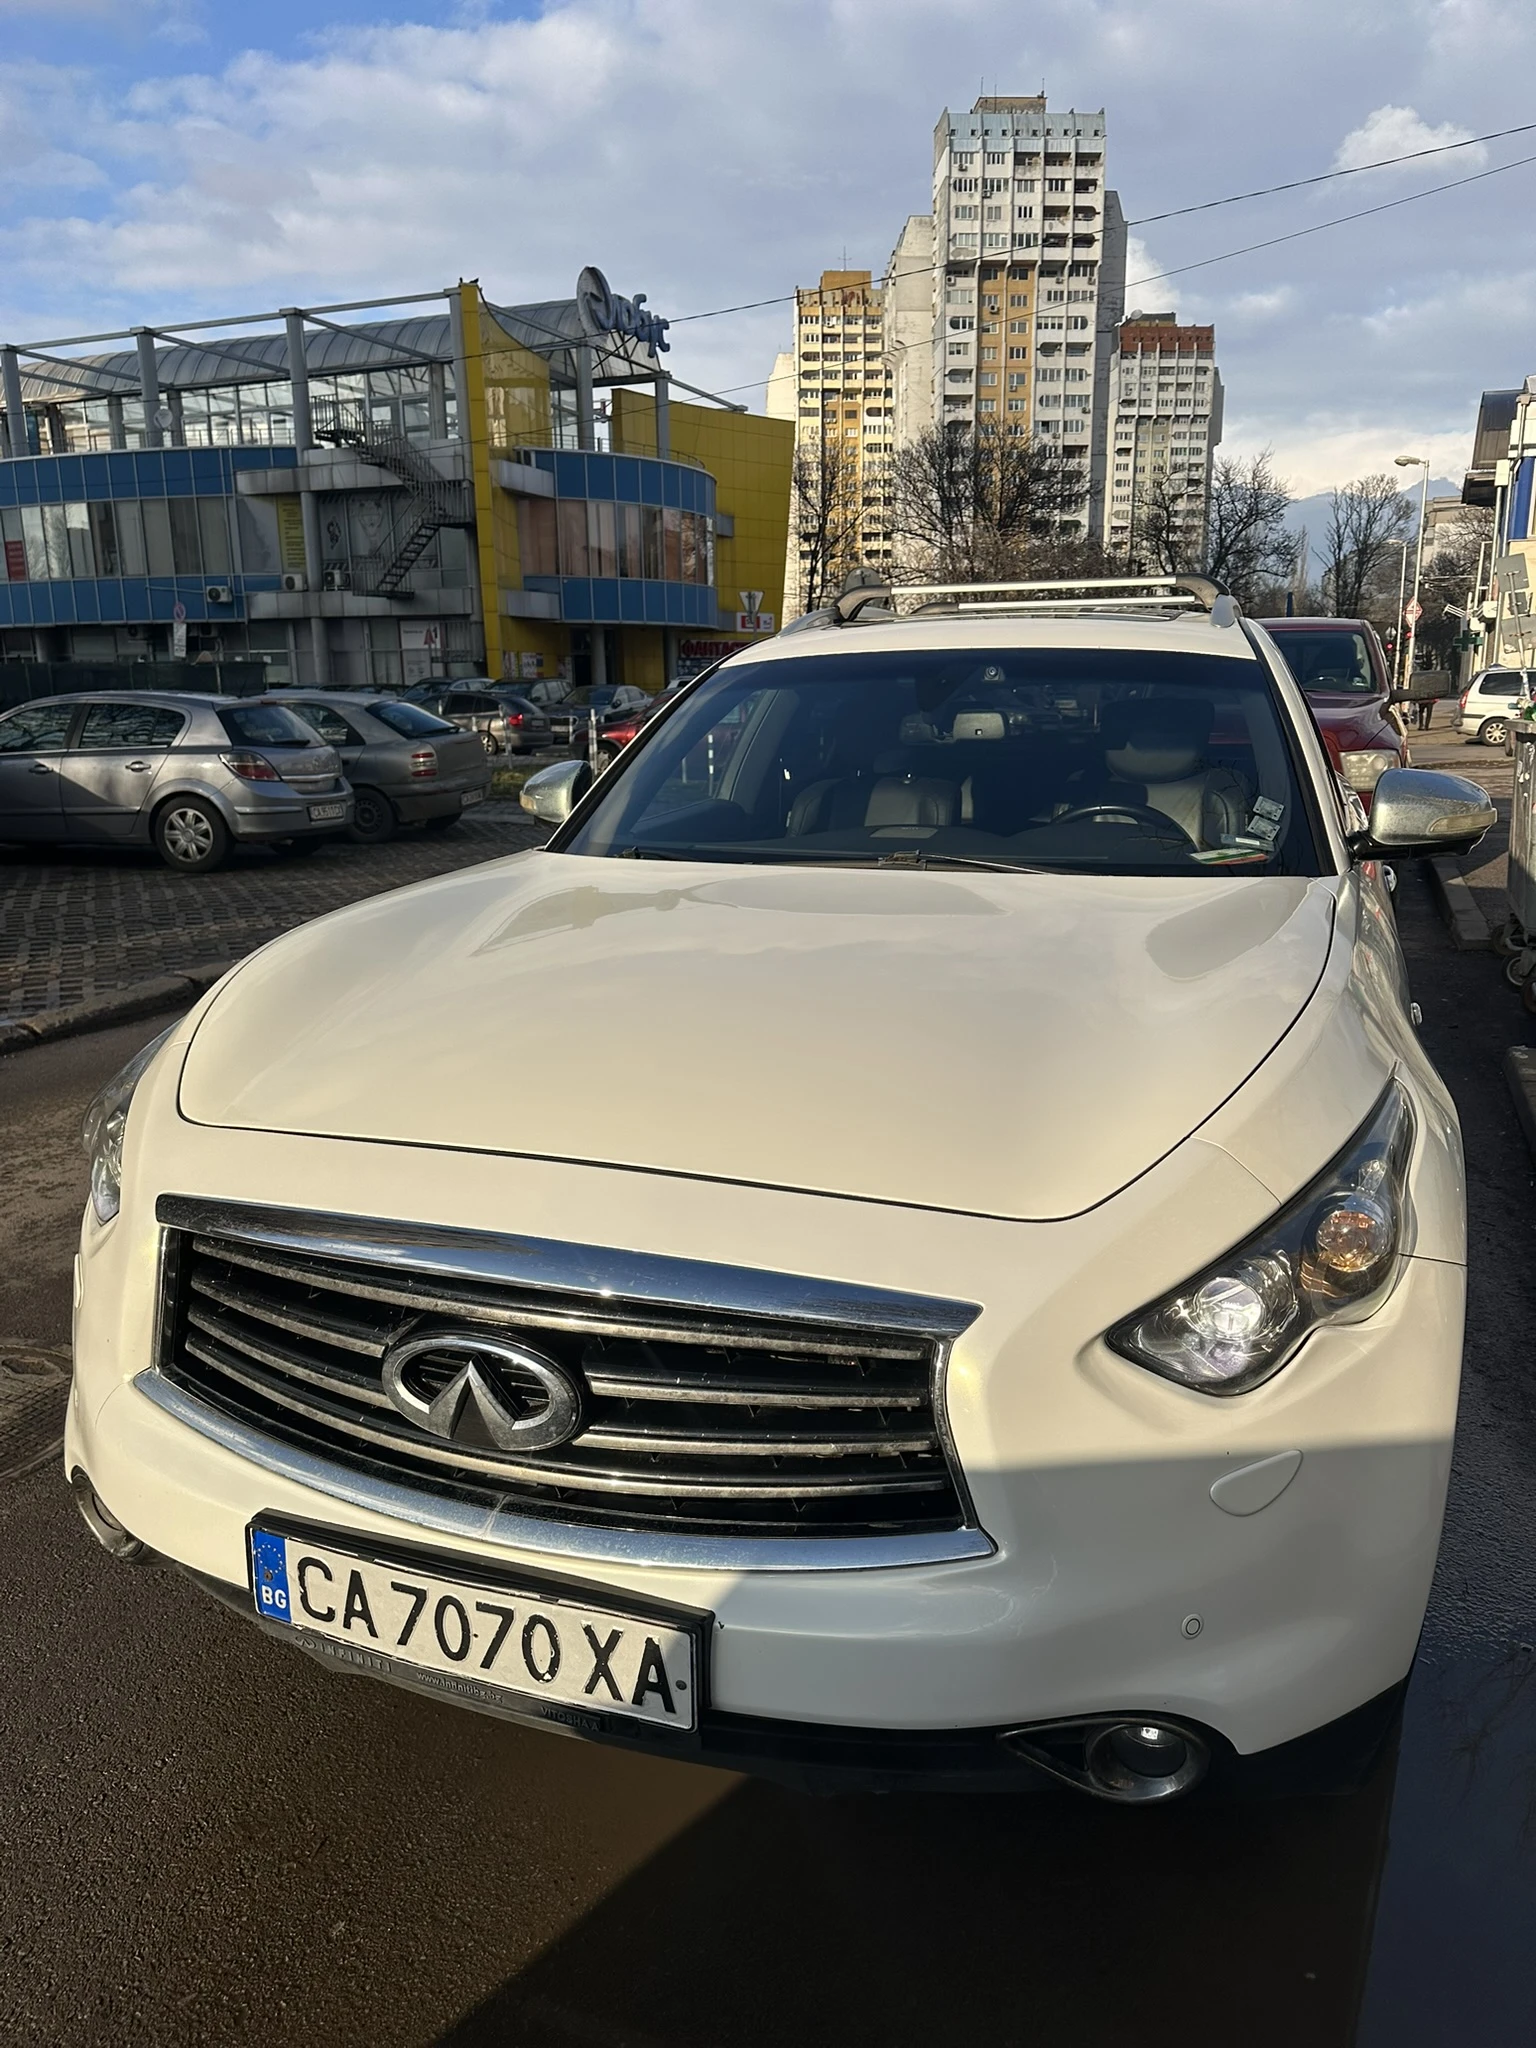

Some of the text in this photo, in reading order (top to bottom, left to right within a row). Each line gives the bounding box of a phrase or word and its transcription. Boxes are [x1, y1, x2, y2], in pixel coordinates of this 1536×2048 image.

[261, 1585, 287, 1609] BG
[298, 1556, 677, 1714] CA 7070 XA
[320, 1643, 393, 1672] INFINITI
[540, 1706, 589, 1729] VITOSHA
